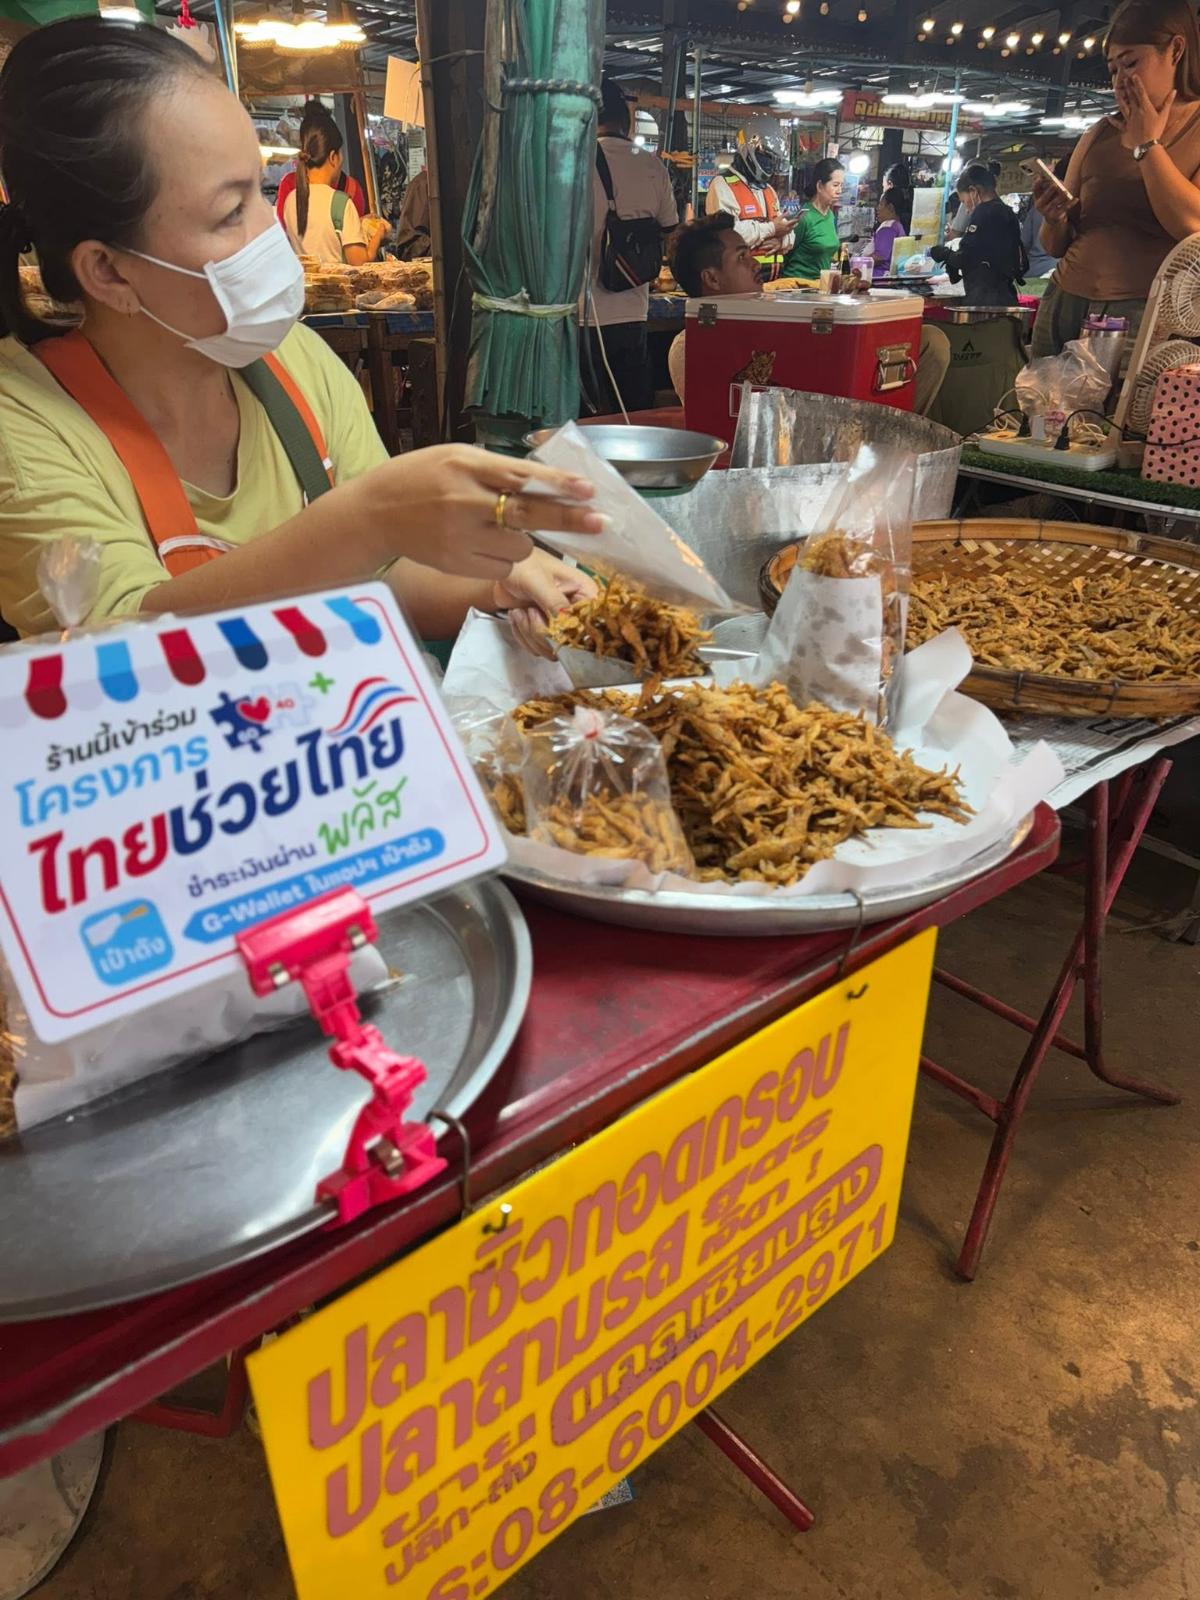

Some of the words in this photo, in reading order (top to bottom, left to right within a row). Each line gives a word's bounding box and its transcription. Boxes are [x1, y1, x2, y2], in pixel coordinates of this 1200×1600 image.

[14, 735, 210, 828] โครงการ
[46, 708, 197, 772] ร้านนี้เข้าร่วม
[27, 716, 406, 915] ไทยช่วยไทย
[188, 843, 317, 898] ชำระเงินผ่าน
[318, 776, 408, 855] พลัส
[202, 884, 305, 932] G-Wallet
[307, 1019, 851, 1452] ปลาซิวทอดกรอบ
[570, 1164, 872, 1425] แคลเซียมสูง
[325, 1208, 690, 1539] ปลาสามรส
[382, 1411, 537, 1549] ขาย
[384, 1451, 538, 1586] ปลีก-ส่ง
